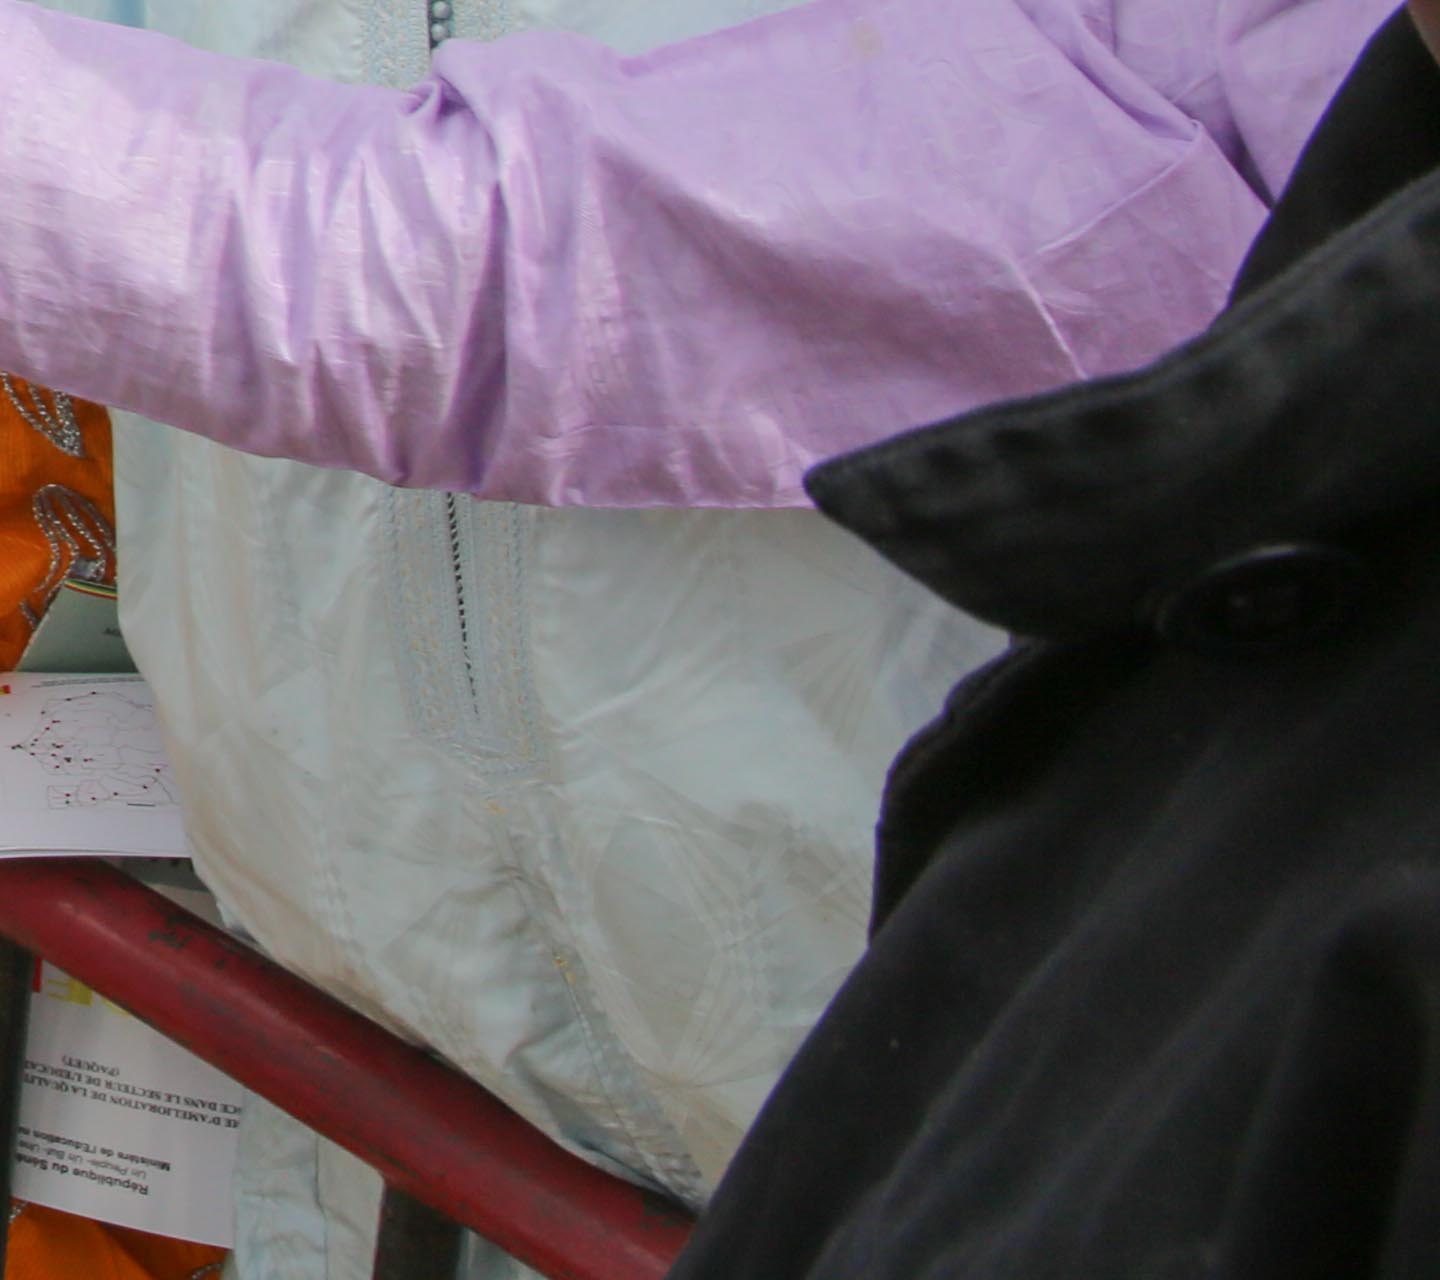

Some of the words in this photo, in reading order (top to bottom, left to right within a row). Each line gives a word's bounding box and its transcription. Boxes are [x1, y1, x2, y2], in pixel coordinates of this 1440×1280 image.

[63, 1054, 119, 1077] (PAQUET)
[84, 1077, 101, 1087] DE
[71, 1086, 87, 1097] LA
[91, 1091, 107, 1102] DE
[105, 1081, 162, 1100] SECTEUR
[164, 1093, 181, 1104] LE
[184, 1097, 218, 1111] DANS
[110, 1096, 221, 1126] D'AMELIORATION
[100, 1147, 114, 1156] de
[16, 1152, 48, 1171] Séné
[52, 1162, 69, 1174] du
[118, 1151, 170, 1171] Ministère
[72, 1167, 149, 1195] République
